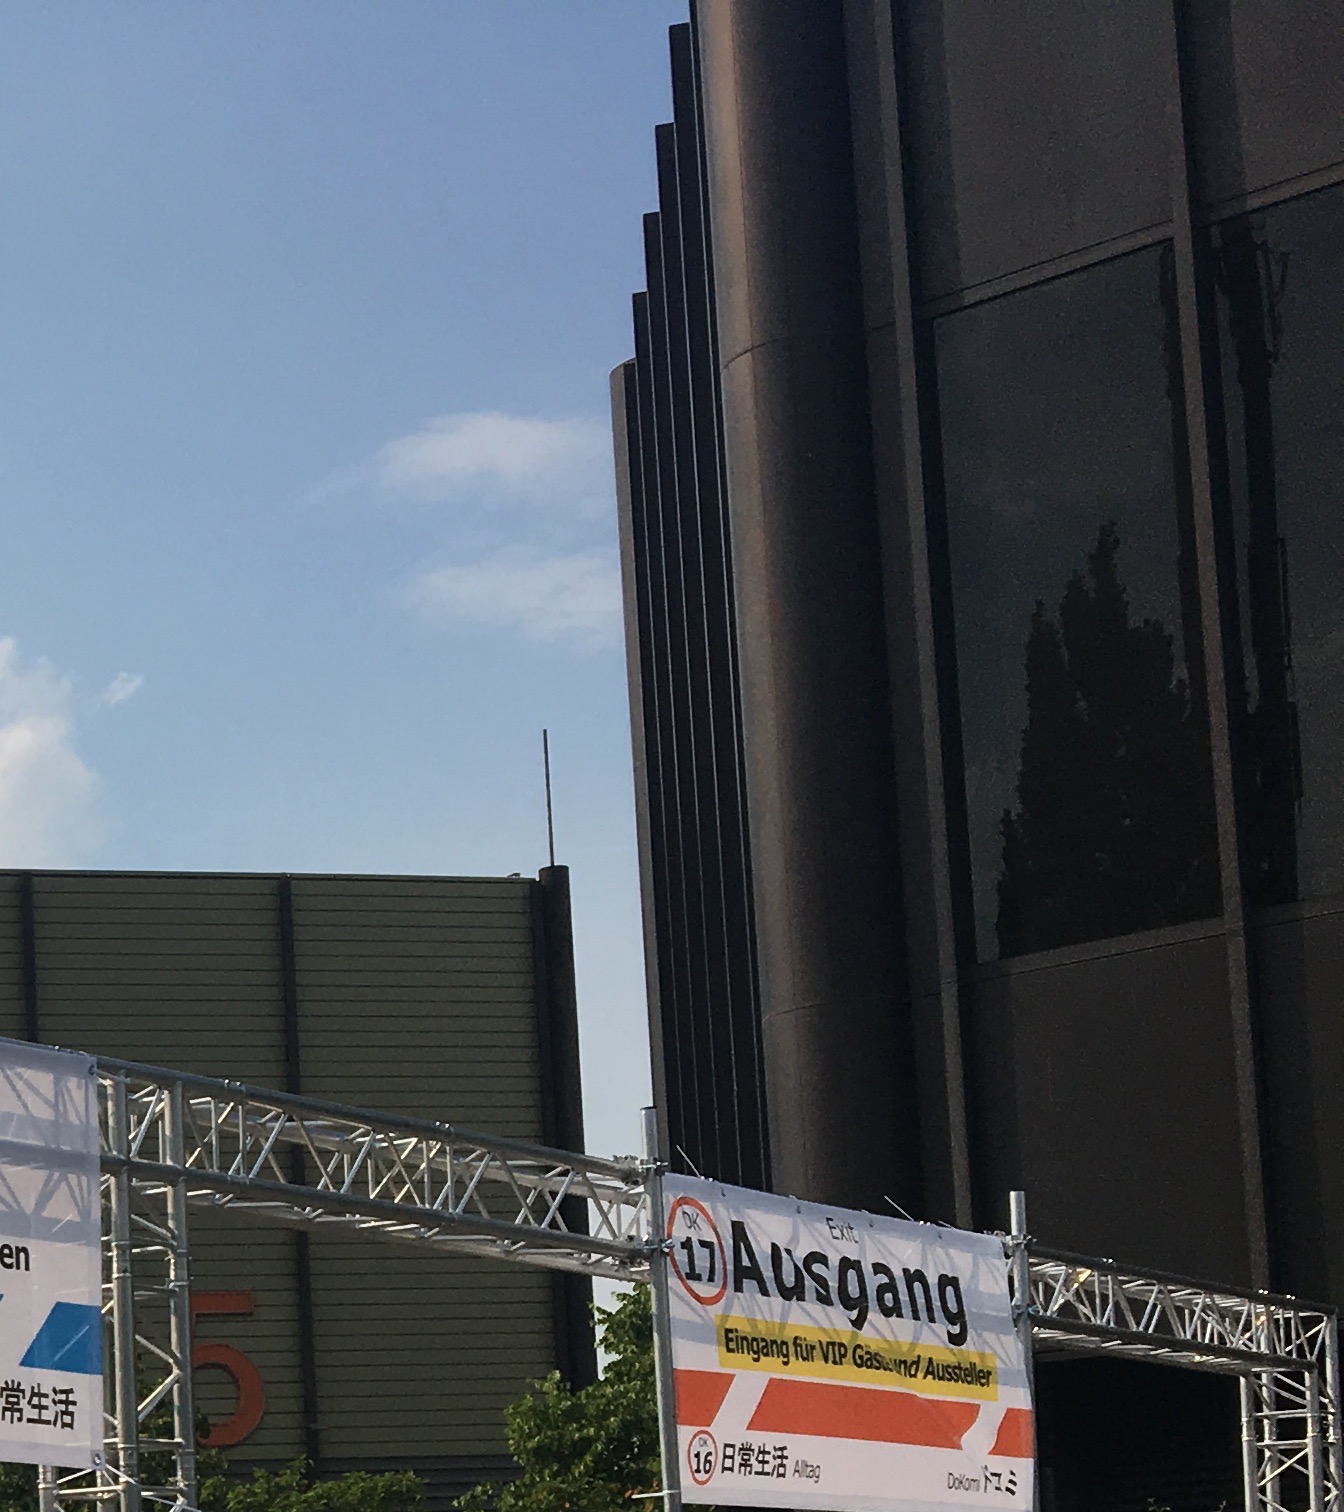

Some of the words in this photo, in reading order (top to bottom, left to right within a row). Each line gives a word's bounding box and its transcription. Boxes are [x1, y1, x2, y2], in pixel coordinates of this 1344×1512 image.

[682, 1211, 702, 1231] DK
[825, 1216, 860, 1245] Exit
[680, 1236, 716, 1283] 17
[730, 1219, 969, 1347] Ausgang
[724, 1328, 790, 1366] Eingang
[793, 1336, 816, 1363] für
[818, 1339, 848, 1367] VIP
[852, 1343, 893, 1372] Gäs
[922, 1356, 993, 1388] Aussteller
[694, 1450, 713, 1475] 16
[721, 1441, 789, 1478] 日常生活
[792, 1459, 821, 1483] Alltag
